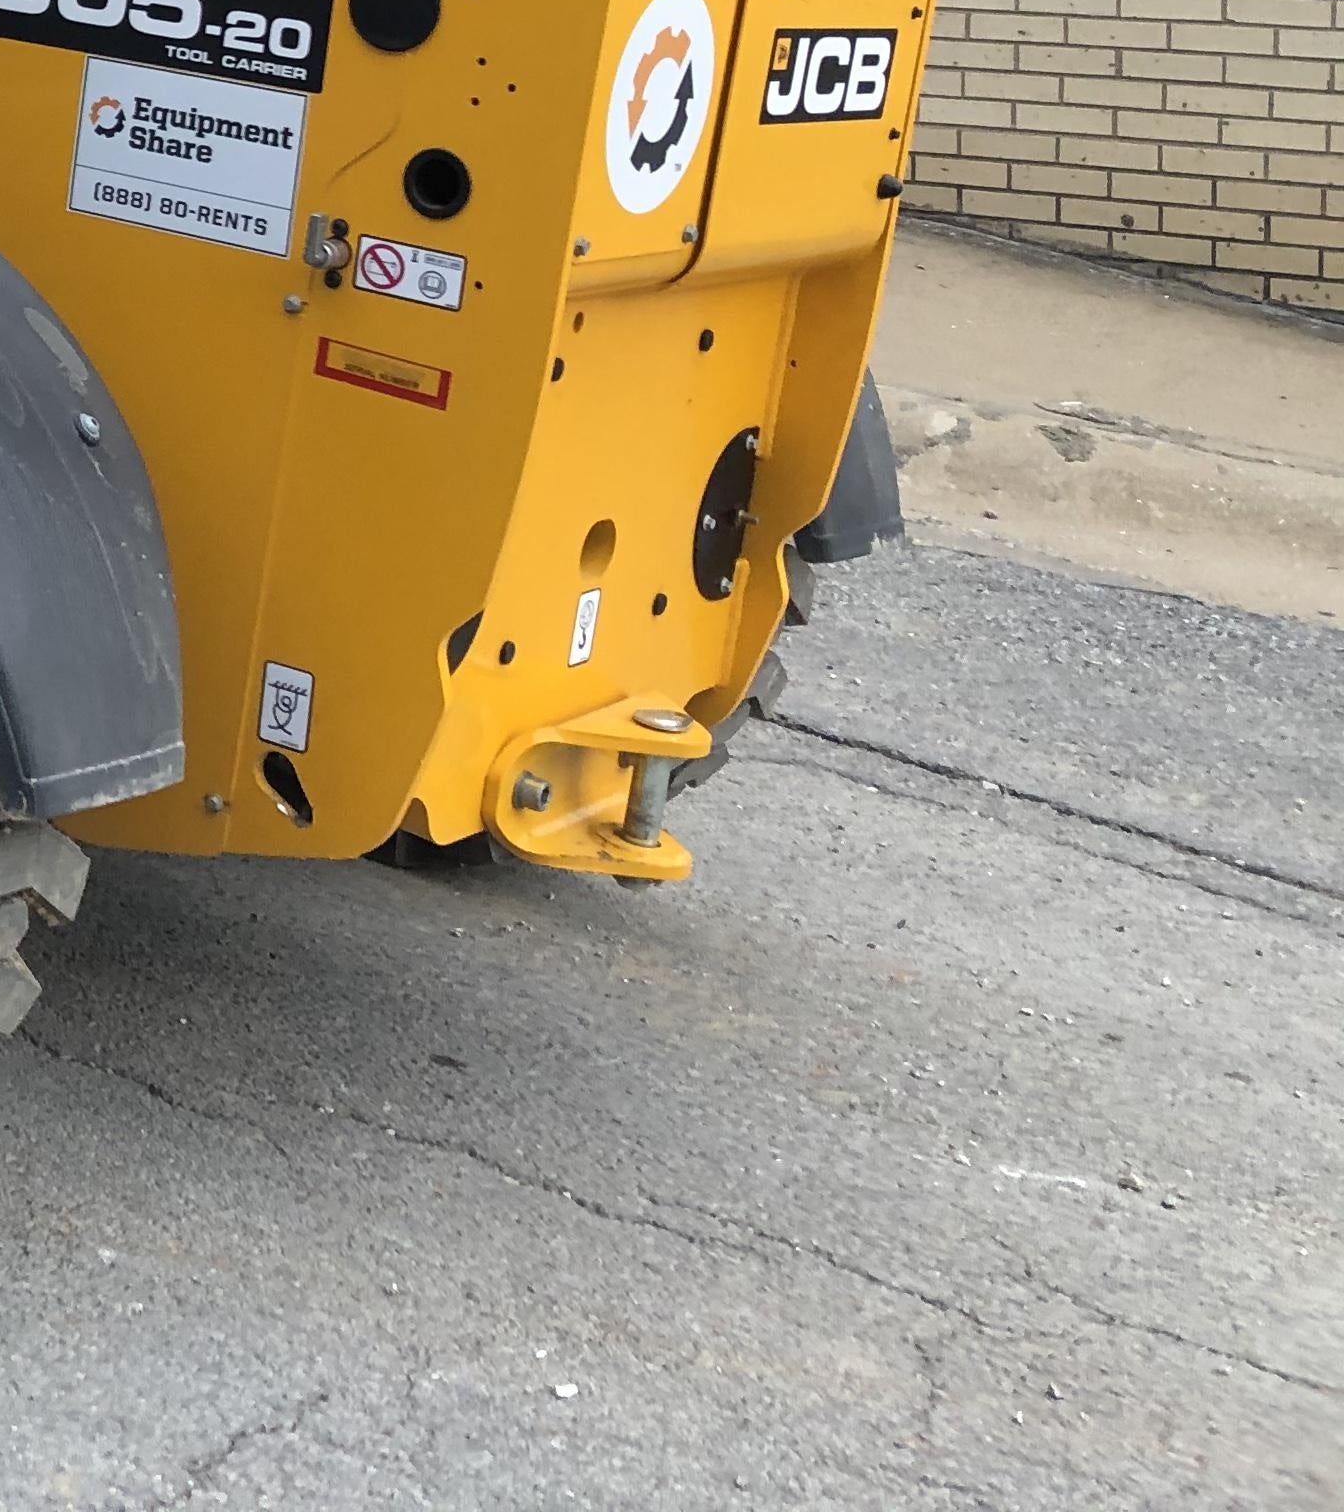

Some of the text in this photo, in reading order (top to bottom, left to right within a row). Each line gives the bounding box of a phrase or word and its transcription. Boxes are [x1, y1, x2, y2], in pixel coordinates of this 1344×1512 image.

[164, 44, 309, 82] TOOL CARRIER
[765, 35, 892, 117] JCB
[127, 125, 214, 164] Share
[131, 96, 295, 151] Equipment
[93, 181, 269, 236] (888) 80-RENTS
